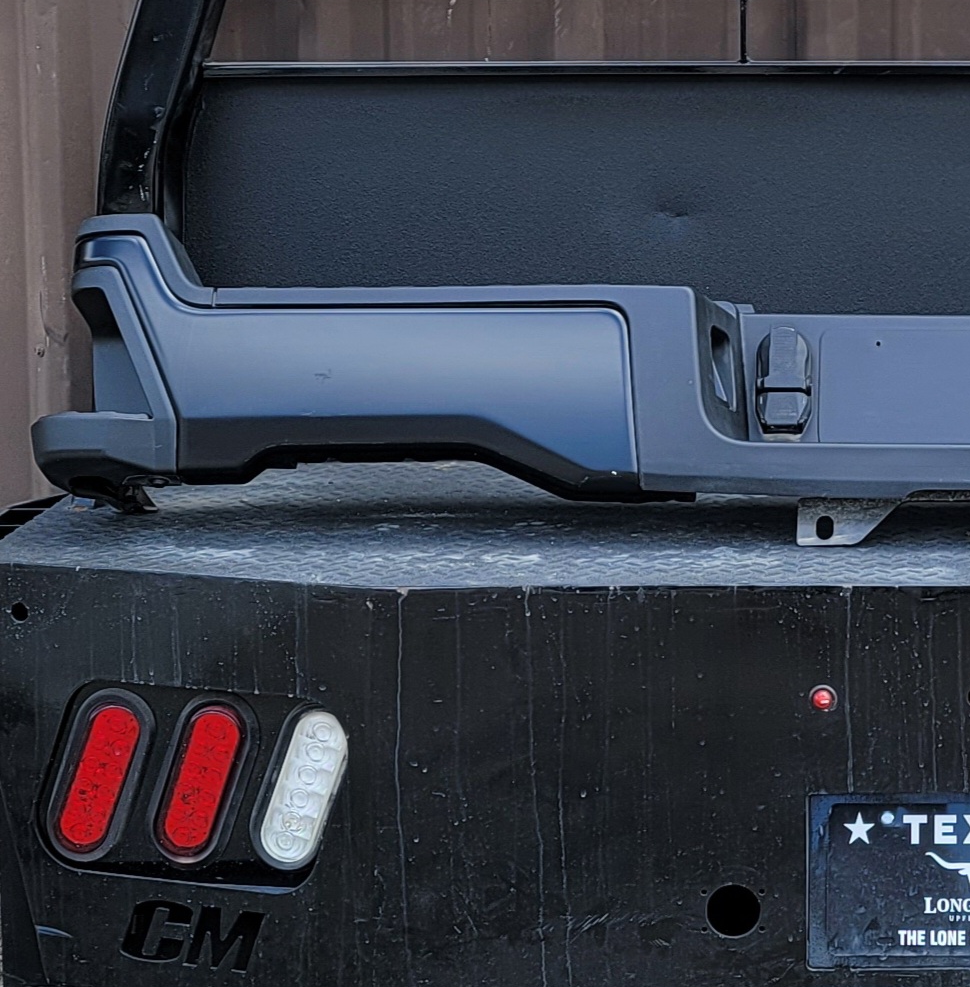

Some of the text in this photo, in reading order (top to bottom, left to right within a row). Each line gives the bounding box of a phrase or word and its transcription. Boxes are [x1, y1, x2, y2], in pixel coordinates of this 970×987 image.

[119, 899, 267, 974] CM
[897, 929, 926, 946] THE
[929, 929, 966, 946] LONE
